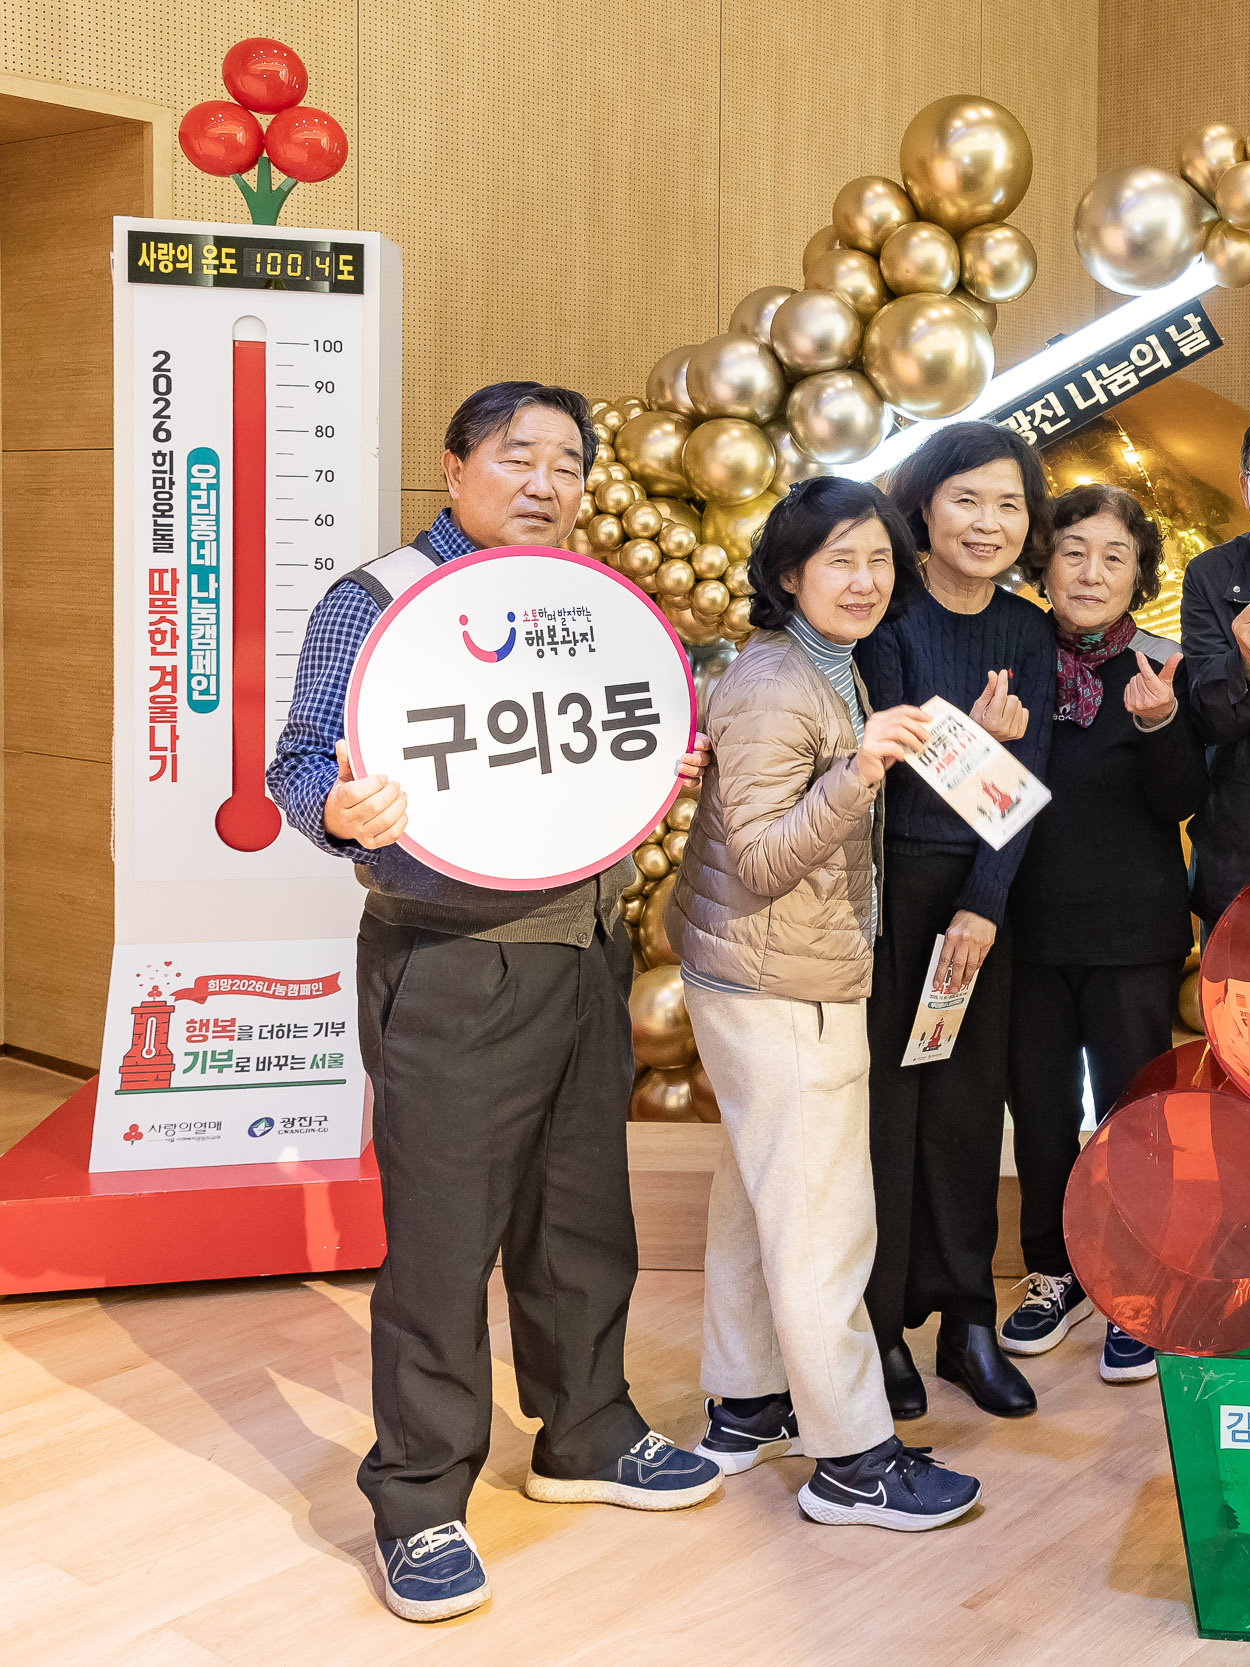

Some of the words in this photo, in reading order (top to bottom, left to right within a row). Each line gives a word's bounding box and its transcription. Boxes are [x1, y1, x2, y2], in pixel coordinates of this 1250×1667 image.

[138, 241, 193, 273] 사랑의
[201, 244, 237, 275] 온도
[313, 339, 343, 353] 100
[1064, 334, 1172, 410] 나눔의
[1165, 313, 1211, 357] 날
[152, 350, 172, 443] 2026
[314, 380, 335, 394] 90
[314, 425, 335, 438] 80
[314, 470, 335, 482] 70
[152, 450, 175, 553] 희망온돌
[190, 463, 218, 567] 우리동네
[314, 514, 335, 527] 60
[314, 558, 335, 571] 50
[148, 568, 179, 656] 따뜻한
[522, 607, 557, 628] 소통하며
[557, 606, 592, 626] 발전하는
[190, 573, 219, 701] 나눔캠페인
[524, 625, 596, 659] 행복광진
[148, 665, 179, 782] 겨울나기
[402, 681, 661, 791] 구의3동
[207, 978, 324, 997] 희망2026나눔캠페인
[185, 1018, 253, 1044] 행복을
[258, 1023, 308, 1041] 더하는
[312, 1021, 346, 1038] 기부
[182, 1049, 251, 1075] 기부로
[255, 1054, 306, 1072] 바꾸는
[309, 1053, 345, 1070] 서울
[277, 1127, 329, 1136] GWANGJIN-GU
[279, 1115, 329, 1129] 광진구
